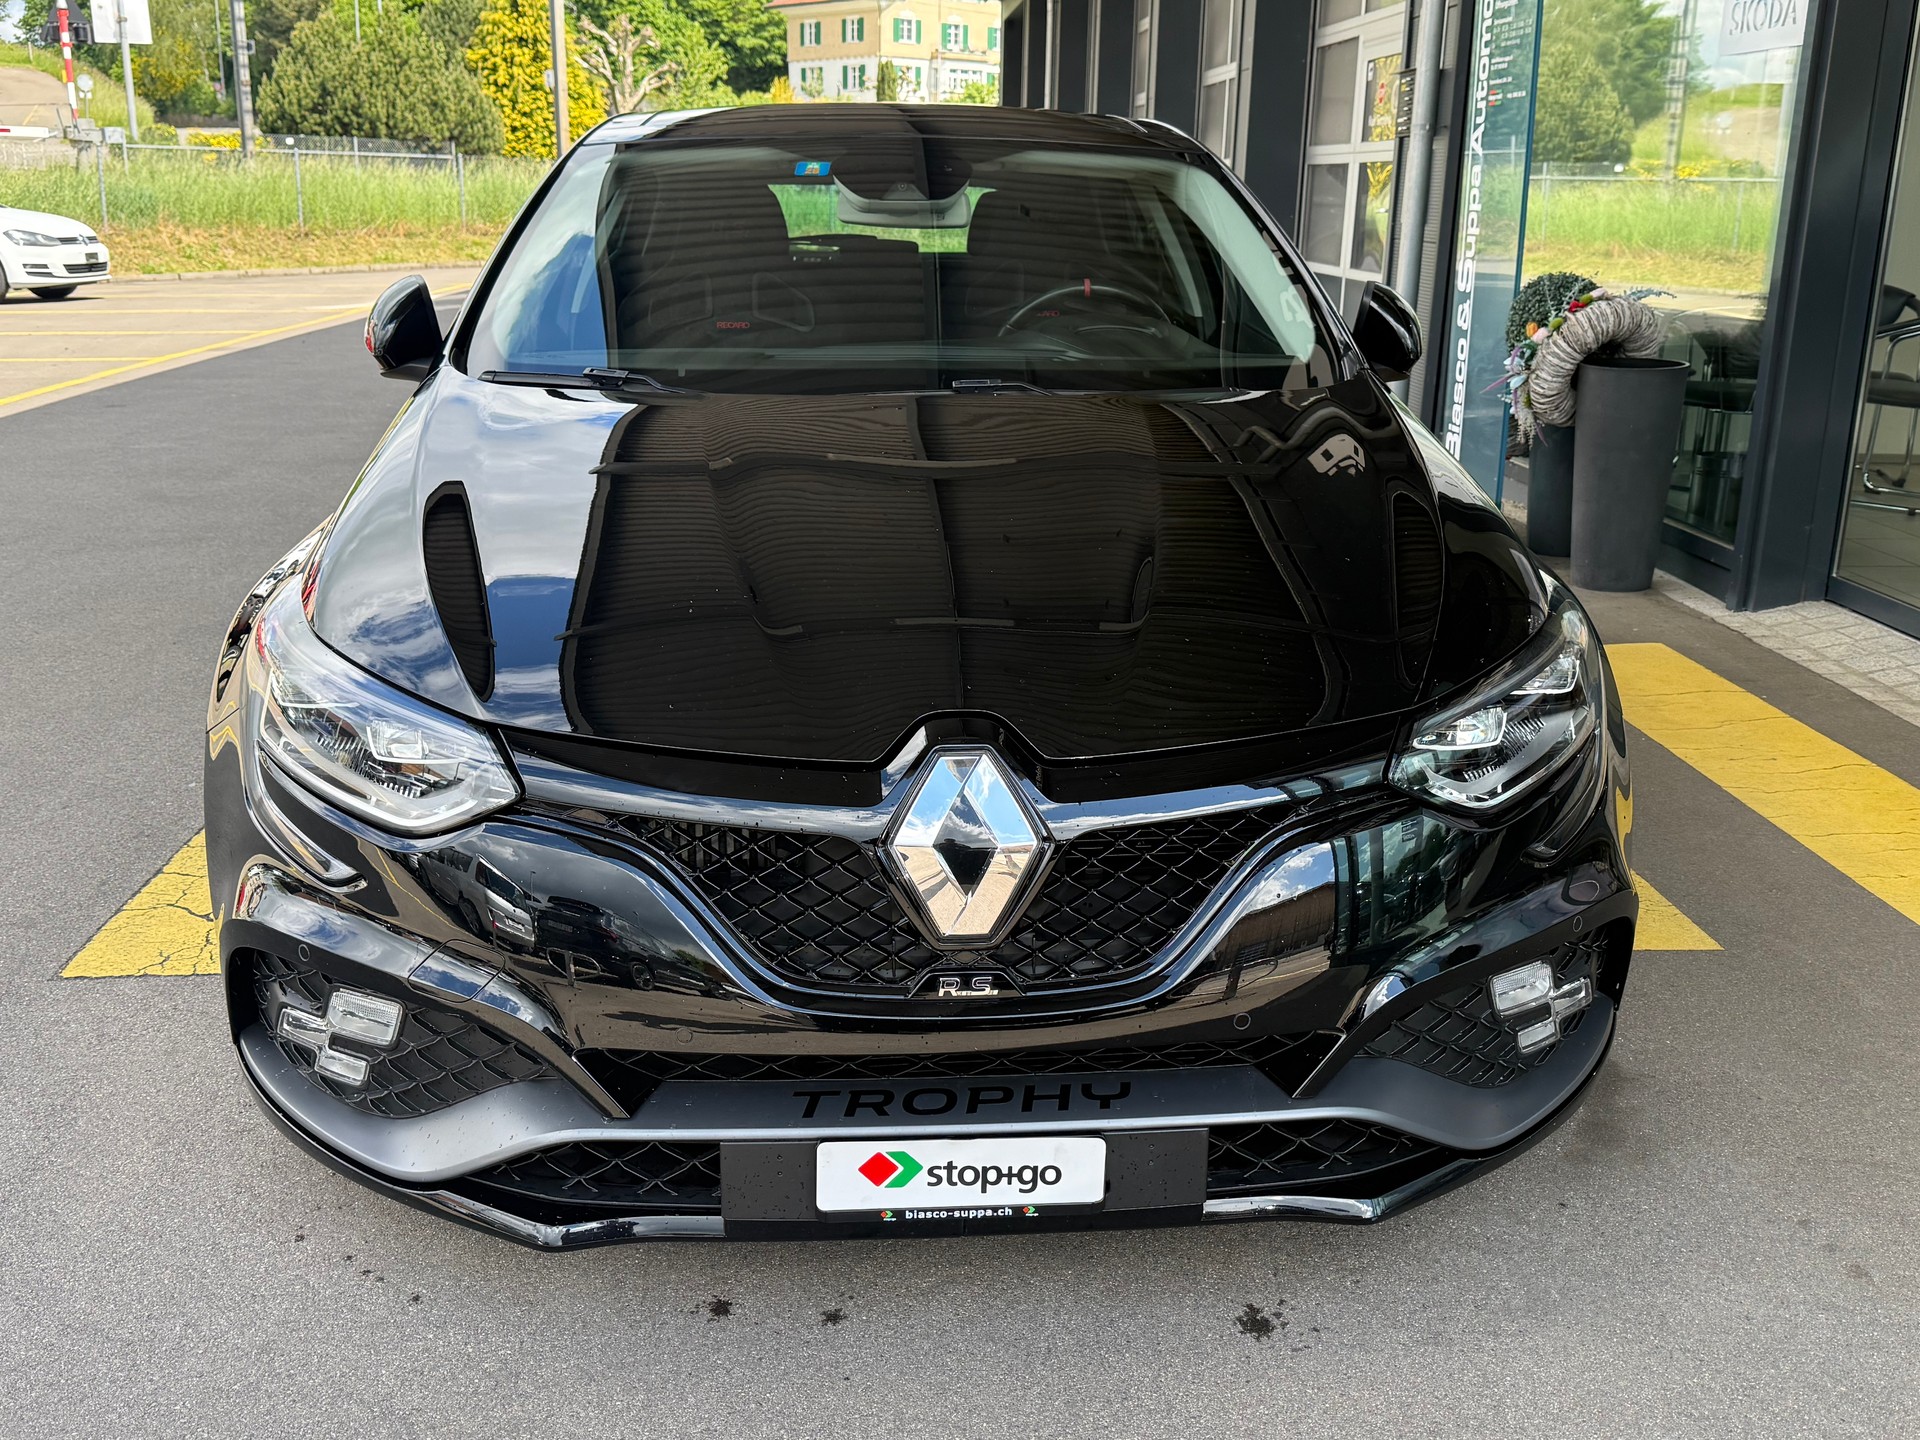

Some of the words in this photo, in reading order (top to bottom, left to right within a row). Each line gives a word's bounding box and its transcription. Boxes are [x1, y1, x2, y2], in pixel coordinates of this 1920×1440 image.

[1457, 164, 1482, 293] Suppa
[716, 321, 751, 329] RECARO
[1457, 299, 1471, 331] &
[792, 1081, 1132, 1119] TROPHY
[926, 1160, 1062, 1194] stop+go
[905, 1207, 1013, 1219] biasco-suppa.ch
